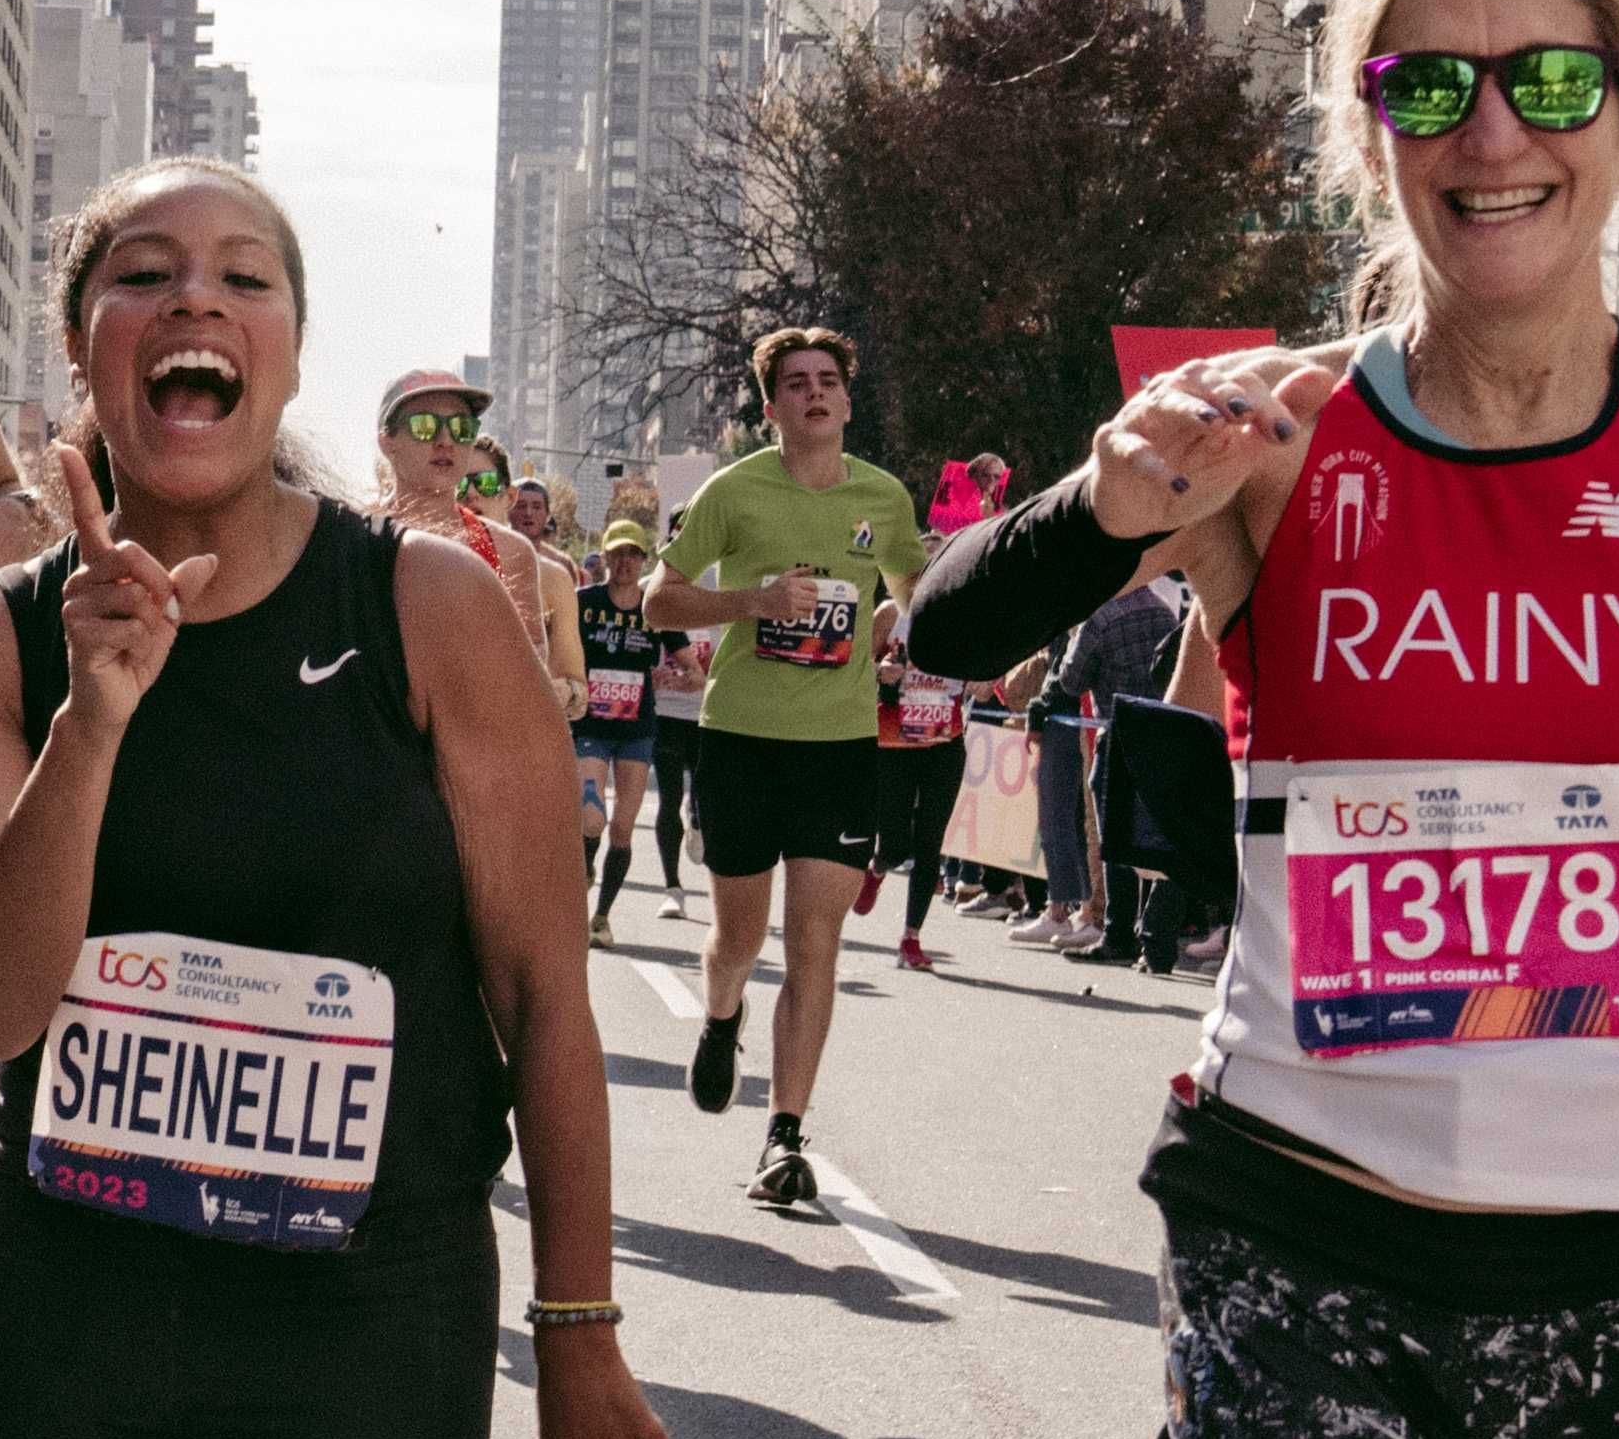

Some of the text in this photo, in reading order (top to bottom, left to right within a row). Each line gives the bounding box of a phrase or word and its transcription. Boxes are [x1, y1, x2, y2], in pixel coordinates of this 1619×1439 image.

[1349, 449, 1373, 465] CITY
[772, 602, 850, 633] 476
[1414, 788, 1462, 803] TATA
[1334, 793, 1409, 839] tcs
[1416, 801, 1526, 820] CONSULTANCY
[1418, 820, 1486, 837] SERVICES
[1553, 814, 1609, 831] TATA
[98, 939, 169, 992] tcs
[180, 951, 224, 969] TATA
[177, 968, 281, 994] CONSULTANCY
[1301, 962, 1521, 991] WAVE 1 PINK CORRAL F
[175, 983, 241, 1005] SERVICES
[305, 1002, 354, 1019] TATA
[52, 1022, 378, 1162] SHEINELLE
[54, 1165, 149, 1209] 2023
